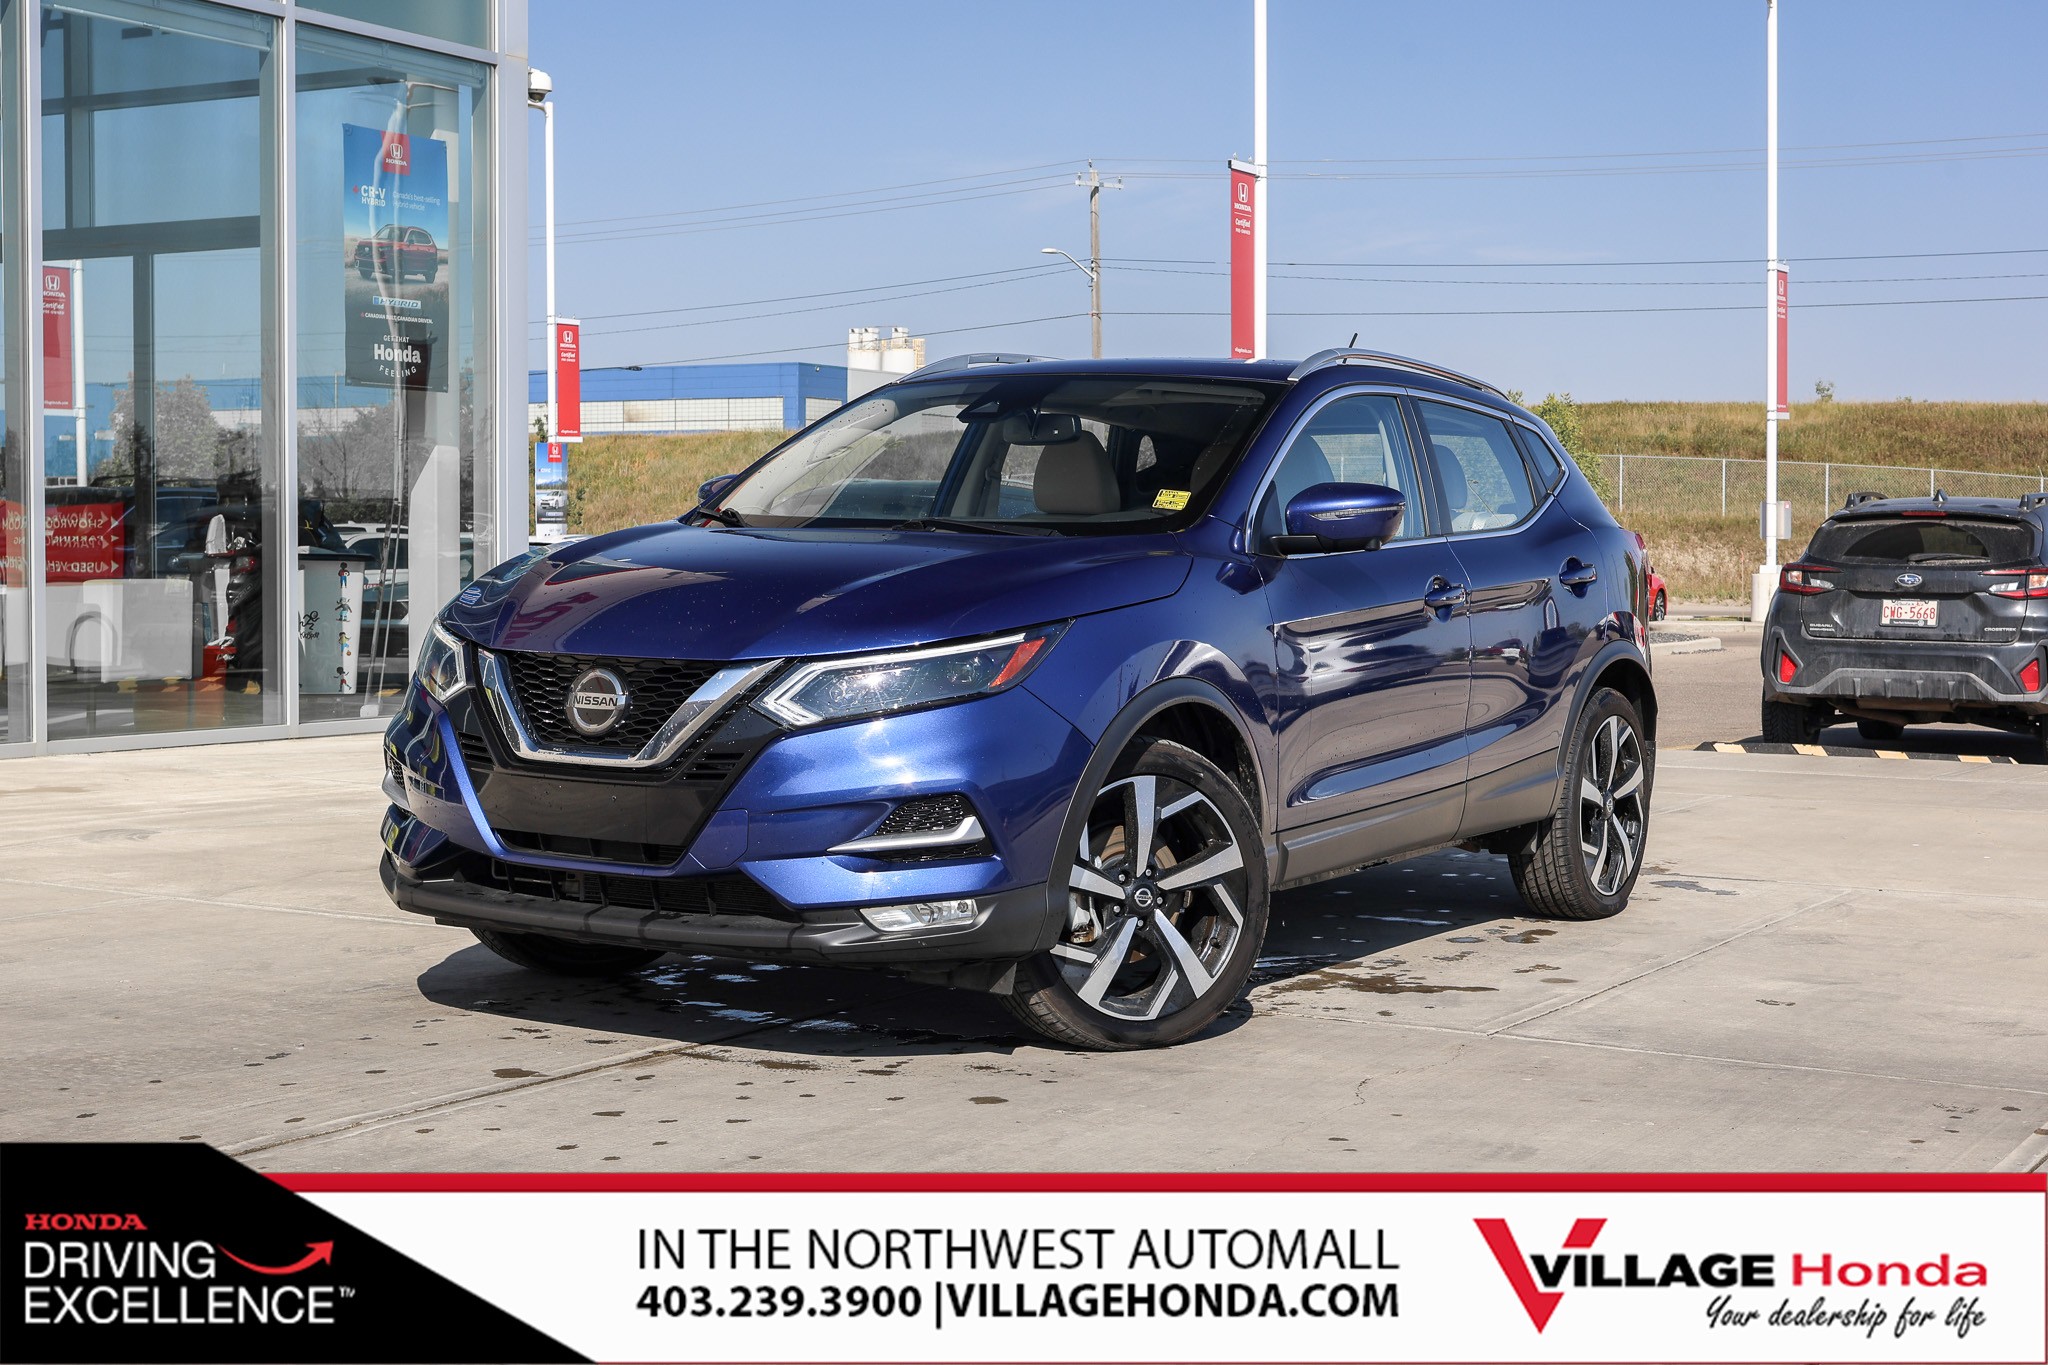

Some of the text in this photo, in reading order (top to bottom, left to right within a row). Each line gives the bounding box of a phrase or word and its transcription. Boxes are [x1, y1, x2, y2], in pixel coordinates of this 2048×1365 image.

[385, 158, 408, 167] HONDA
[361, 185, 386, 199] CR-V
[361, 197, 386, 207] HYBRID
[374, 343, 422, 364] Honda
[379, 364, 417, 378] FEELING
[1883, 606, 1936, 620] CWG-5668
[573, 695, 619, 707] NISSAN
